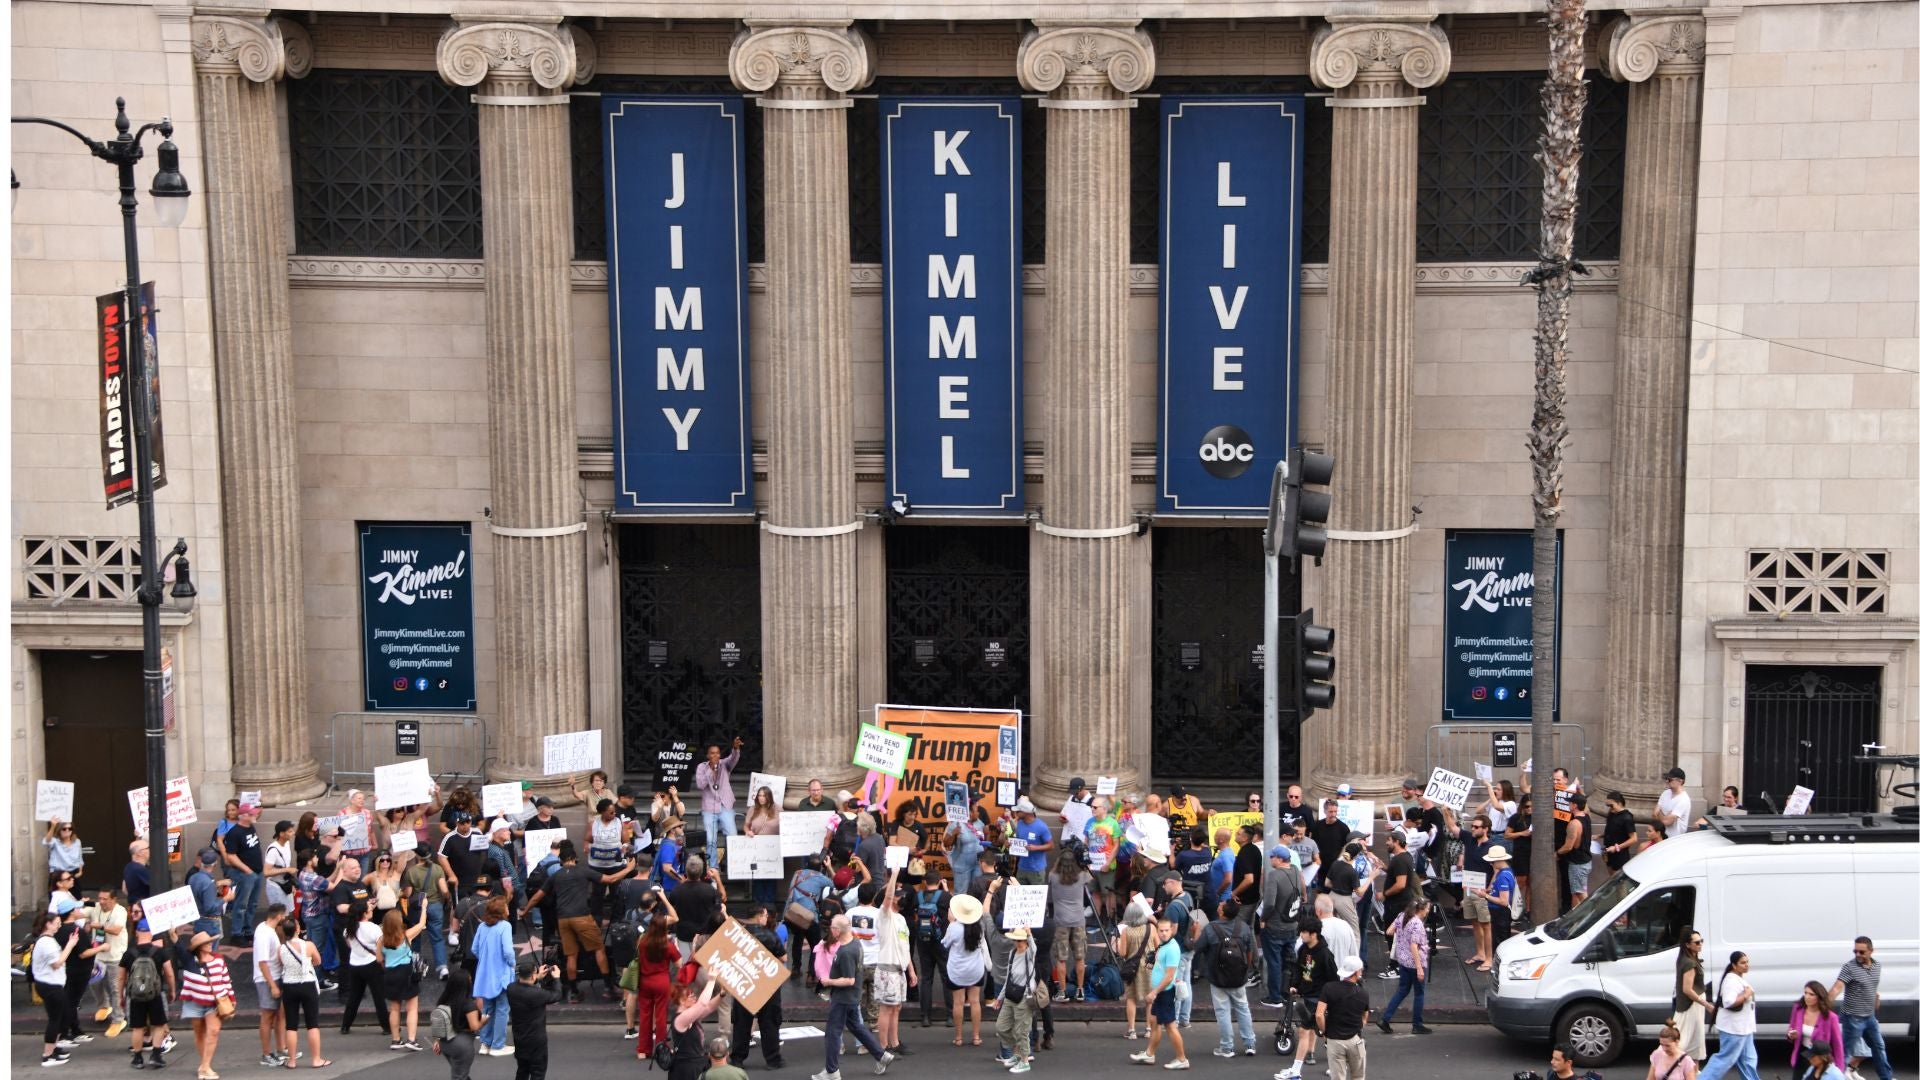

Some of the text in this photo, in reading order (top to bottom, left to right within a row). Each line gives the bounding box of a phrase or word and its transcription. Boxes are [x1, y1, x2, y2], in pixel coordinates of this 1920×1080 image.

[1209, 162, 1249, 390] LIVE
[655, 153, 705, 450] JIMMY
[928, 130, 977, 478] KIMMEL
[103, 304, 126, 476] HADESTOWN
[1199, 437, 1255, 462] abc
[380, 550, 419, 564] JIMMY
[1464, 556, 1505, 571] JIMMY
[369, 550, 465, 605] Kimmel
[419, 589, 453, 599] LIVE!
[1452, 570, 1535, 613] Kimm
[1503, 597, 1532, 607] LIVE
[373, 628, 465, 640] JimmyKimmelLive.com
[1454, 636, 1534, 648] JimmyKimmelLive.c
[380, 643, 460, 654] @JimmyKimmelLive
[389, 658, 453, 669] @JimmyKimmel
[1460, 652, 1533, 663] @JimmyKimmelLi
[573, 734, 590, 745] LIKE
[884, 738, 900, 749] BEND
[672, 742, 687, 750] NO
[868, 743, 883, 752] KNEE
[887, 748, 894, 756] TO
[905, 733, 991, 767] Trump
[658, 751, 693, 761] KINGS
[1000, 756, 1015, 765] FREE
[1433, 770, 1469, 792] CANCEL
[913, 795, 946, 819] No
[948, 805, 966, 815] FREE
[1211, 816, 1231, 827] KEEP
[1009, 839, 1026, 848] FREE
[724, 921, 779, 977] JIMMY SAID
